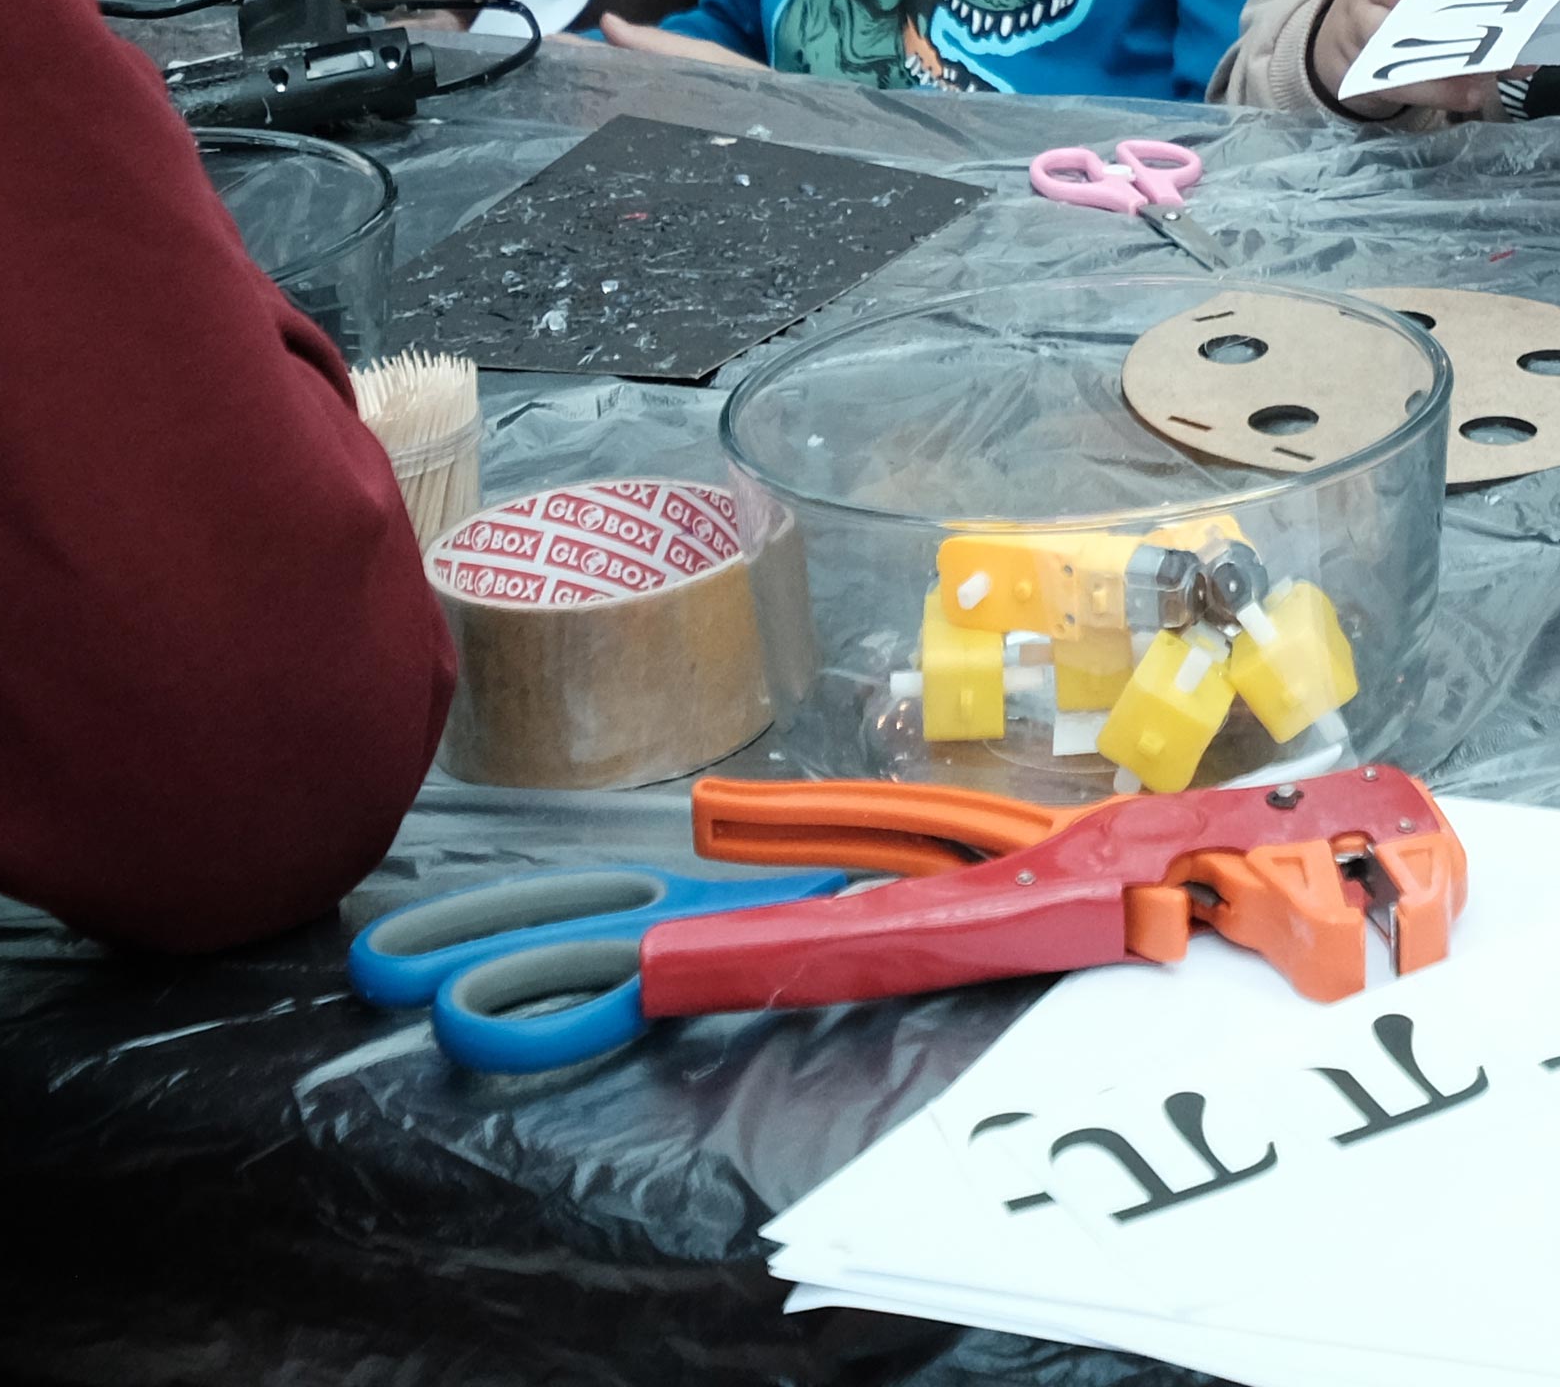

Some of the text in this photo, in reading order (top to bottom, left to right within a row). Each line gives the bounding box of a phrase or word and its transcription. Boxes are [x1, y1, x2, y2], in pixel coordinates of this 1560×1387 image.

[547, 499, 657, 550] GLOBOX
[456, 568, 541, 601] GLOBOX
[550, 543, 659, 589] GLOBOX
